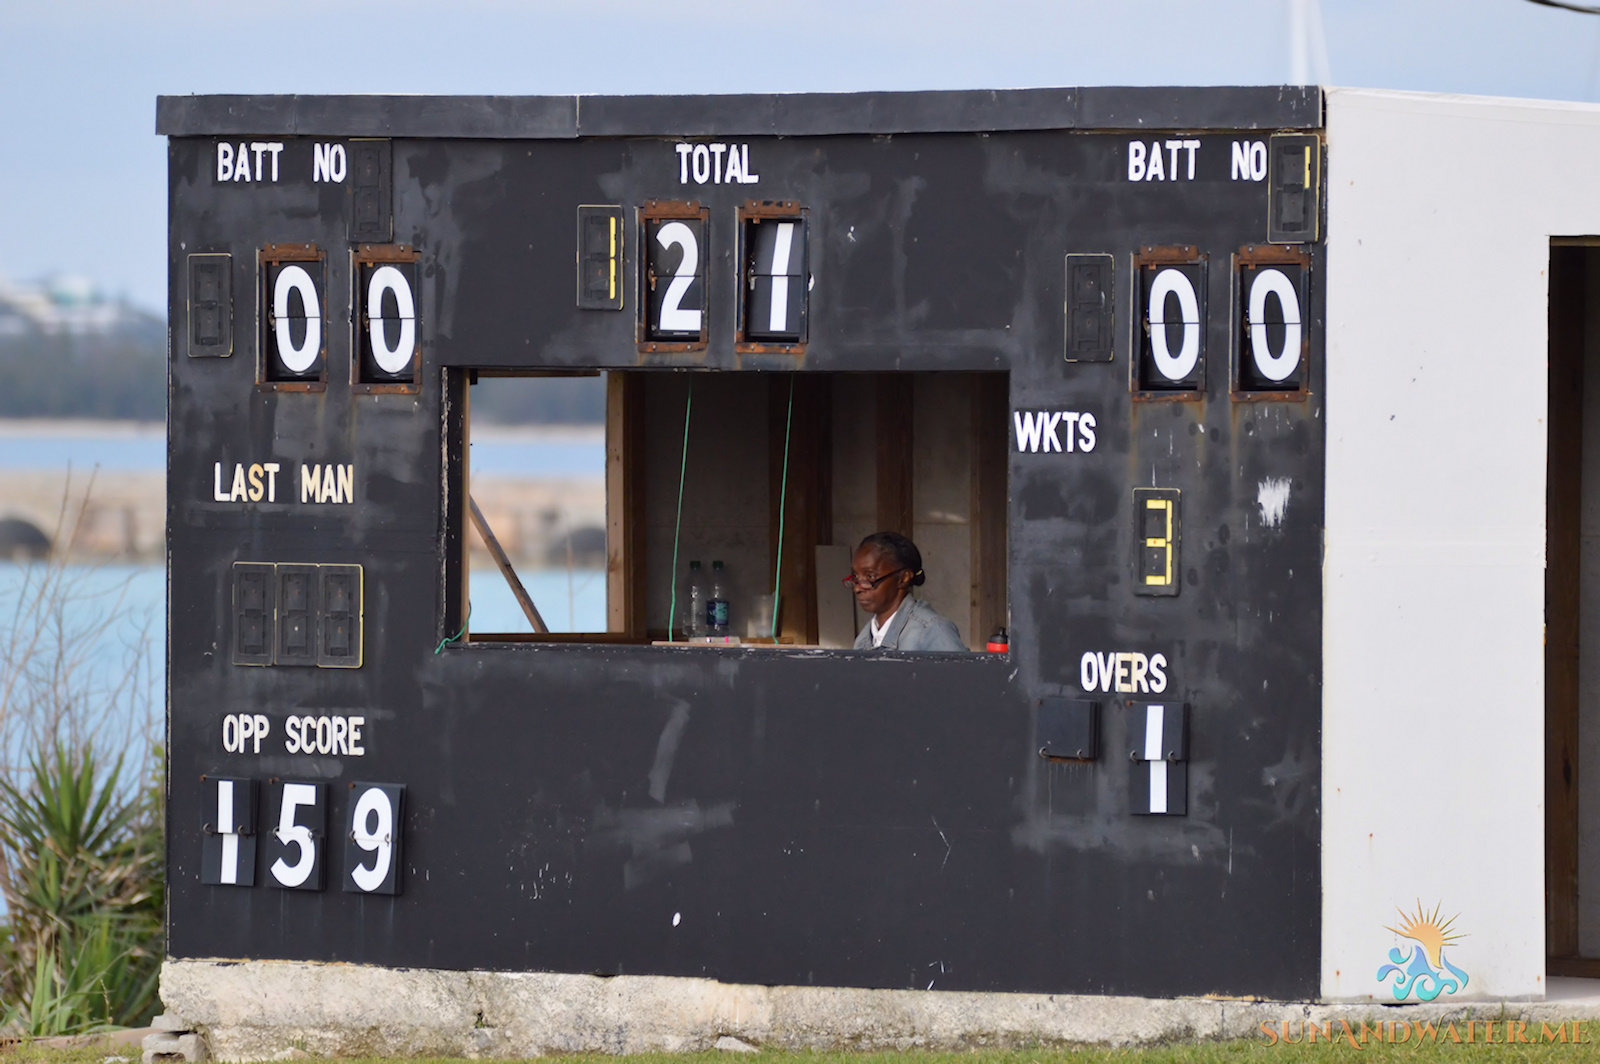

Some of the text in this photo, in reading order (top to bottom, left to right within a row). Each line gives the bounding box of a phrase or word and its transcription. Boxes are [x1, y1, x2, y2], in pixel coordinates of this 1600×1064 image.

[217, 142, 347, 183] BATT NO
[675, 143, 759, 185] TOTAL
[1127, 139, 1267, 182] BATT NO
[1013, 411, 1097, 453] WKTS
[214, 462, 354, 504] LAST MAN
[1145, 499, 1173, 586] 3
[1080, 651, 1167, 694] OVERS
[222, 713, 365, 756] OPP SCORE
[1144, 705, 1167, 813] 1
